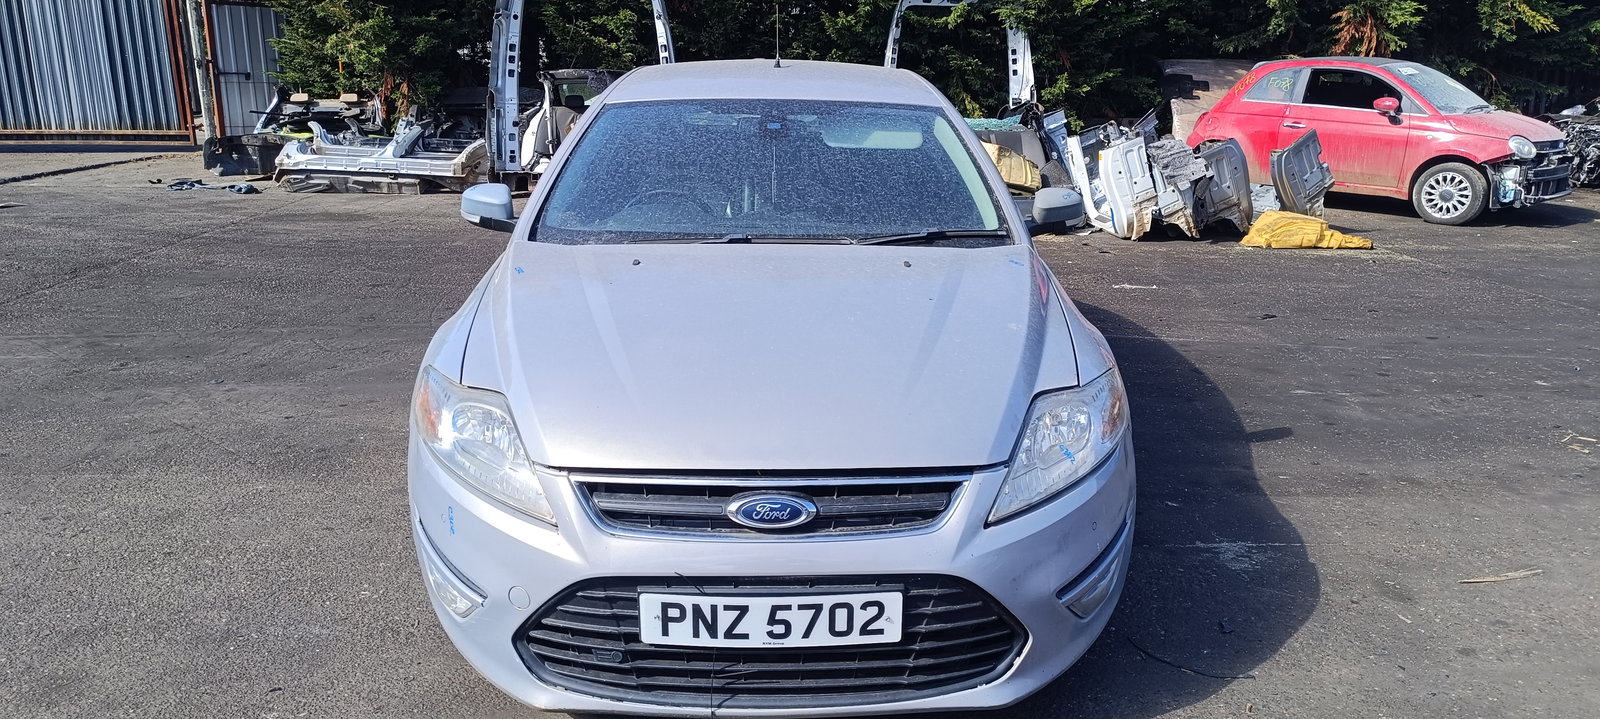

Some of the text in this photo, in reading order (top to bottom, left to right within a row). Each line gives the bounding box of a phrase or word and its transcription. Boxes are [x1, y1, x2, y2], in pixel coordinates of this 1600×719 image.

[1234, 72, 1256, 96] F078
[1268, 77, 1293, 91] F078
[752, 503, 791, 520] Ford
[660, 600, 886, 640] PNZ 5702
